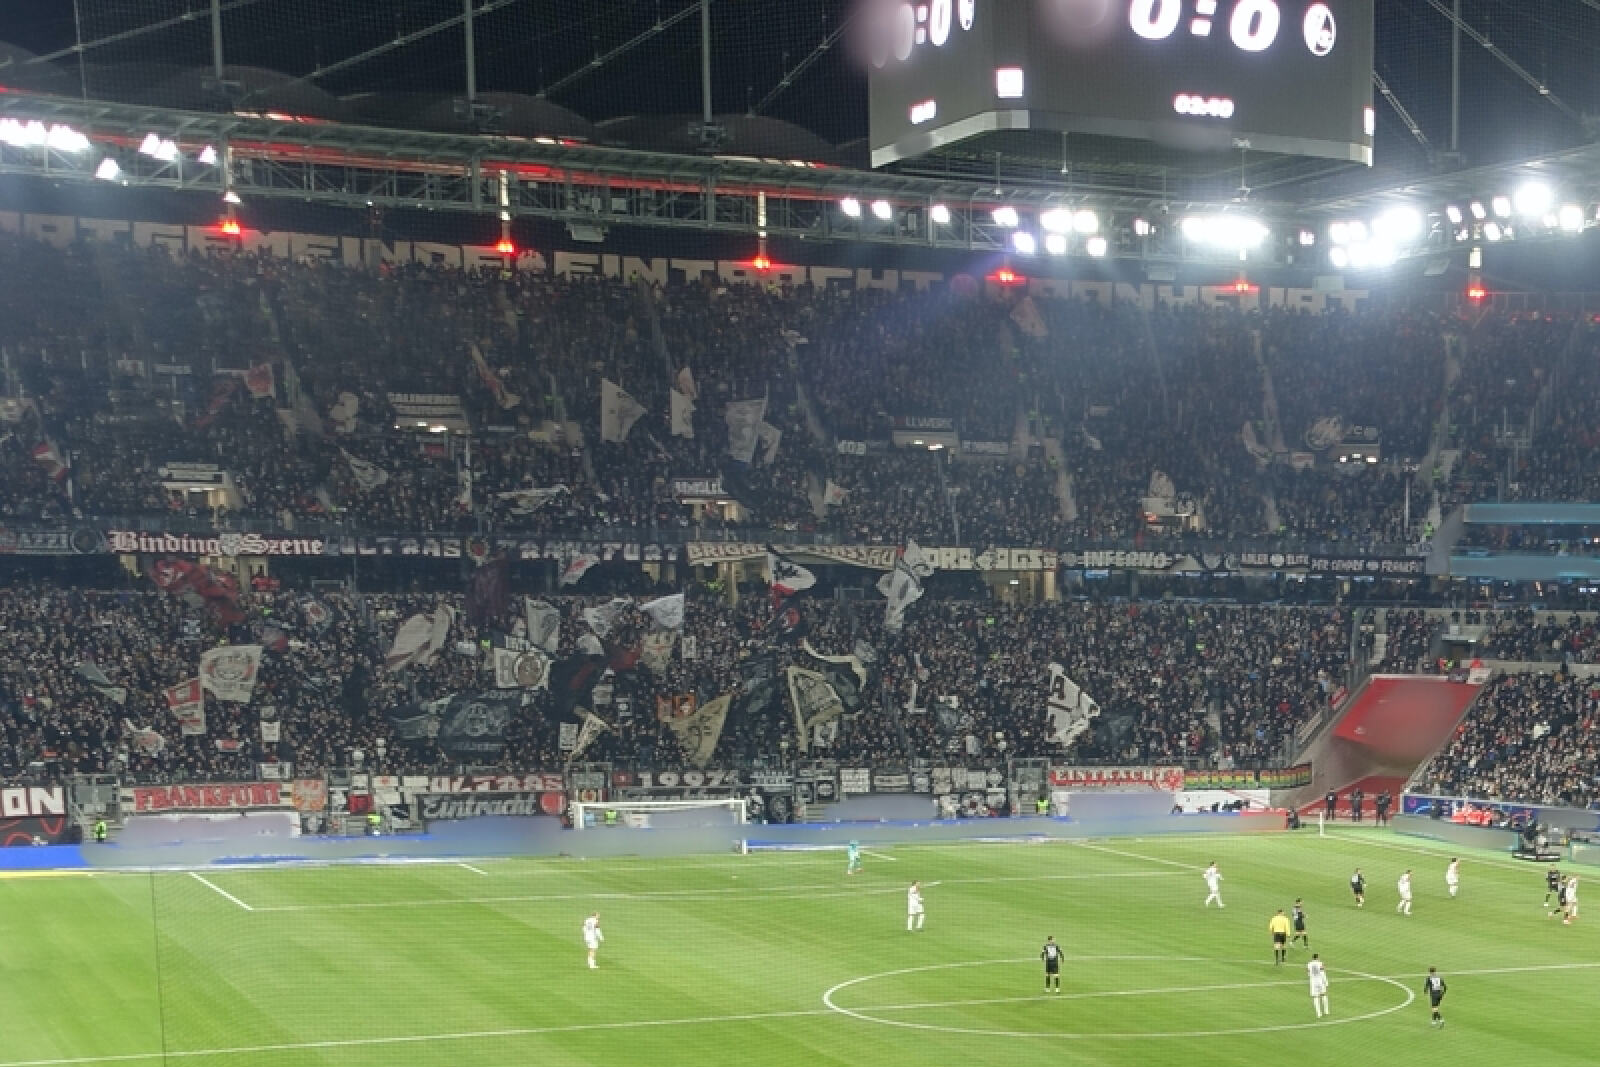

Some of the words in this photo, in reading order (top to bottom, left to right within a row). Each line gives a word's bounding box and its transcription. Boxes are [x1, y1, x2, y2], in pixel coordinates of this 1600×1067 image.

[107, 531, 220, 557] Binding
[240, 533, 324, 556] Szene
[430, 774, 564, 794] ULTRAS
[1055, 768, 1168, 783] EINTRACHT
[133, 783, 281, 812] FRANKFURT
